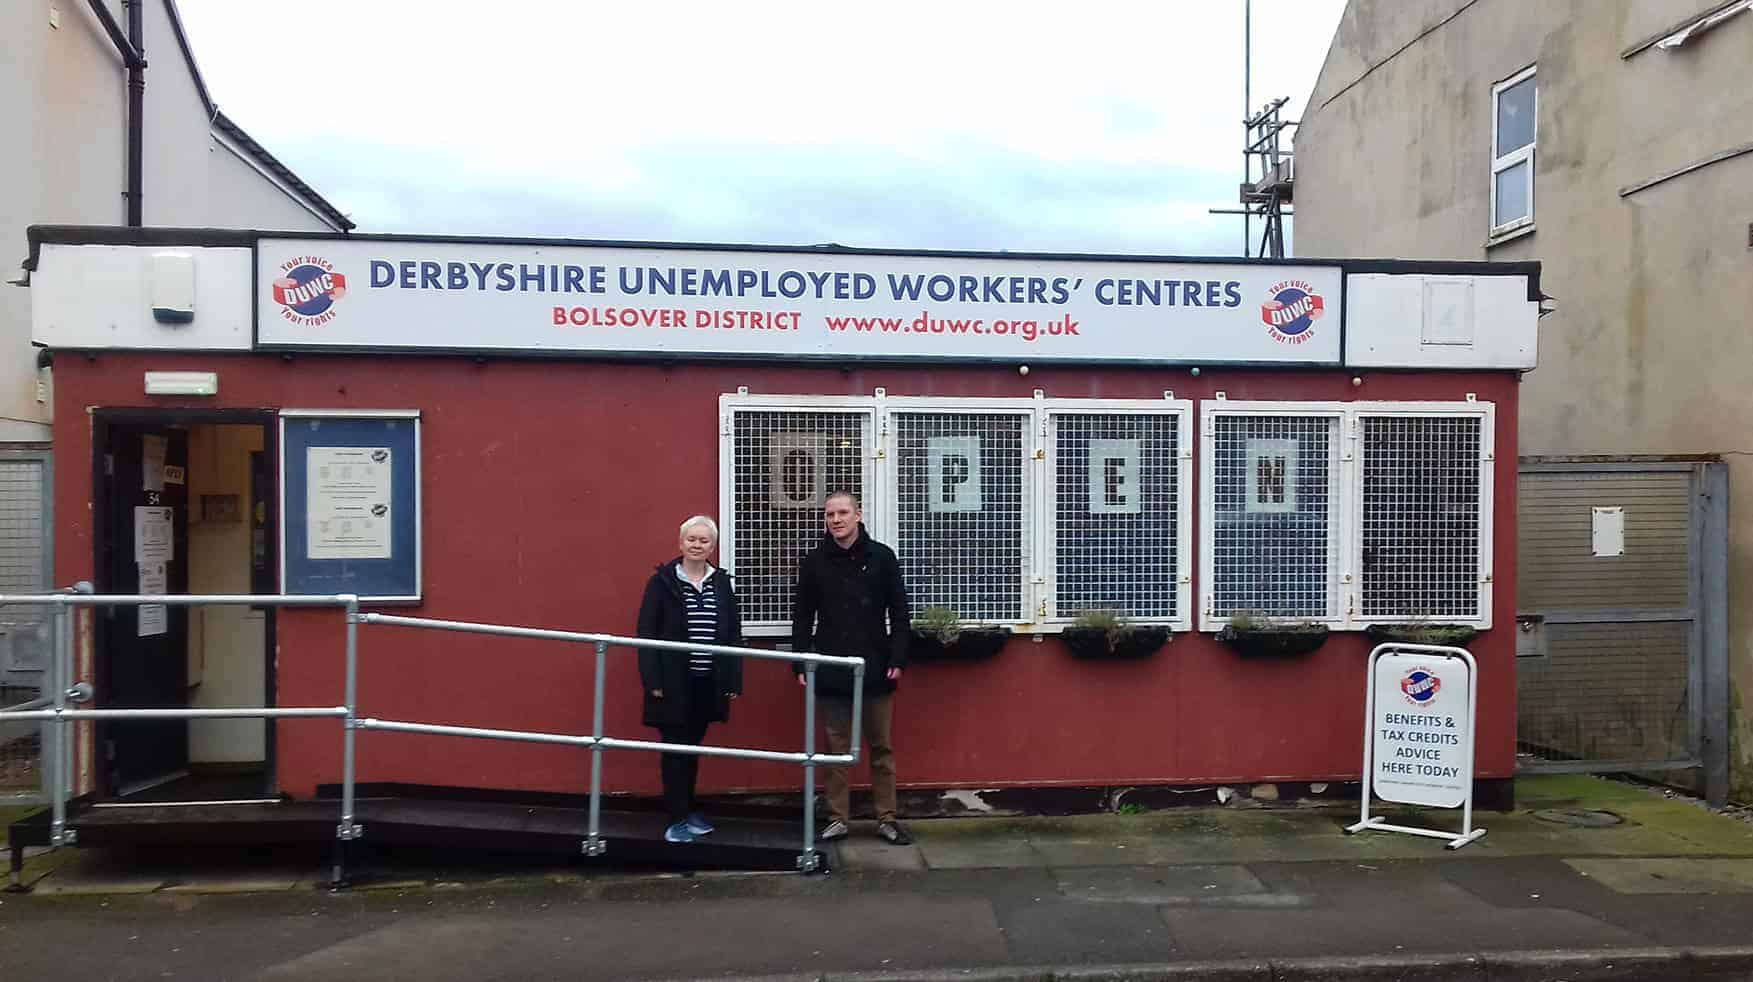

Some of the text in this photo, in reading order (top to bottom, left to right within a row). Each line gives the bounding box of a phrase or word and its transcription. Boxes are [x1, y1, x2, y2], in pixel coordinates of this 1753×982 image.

[279, 255, 334, 273] Your voice
[283, 273, 335, 305] DUWC
[370, 260, 606, 293] DERBYSHIRE
[619, 267, 876, 300] UNEMPLOYED
[1095, 279, 1242, 308] CENTRES
[1268, 280, 1314, 296] Your voice
[280, 306, 337, 327] Your rights
[553, 307, 801, 331] BOLSOVER DISTRICT
[1271, 296, 1314, 325] DUWC
[825, 311, 1080, 341] www.duwc.org.uk
[1267, 326, 1315, 345] Your rights
[1385, 713, 1456, 728] BENEFITS &
[1382, 729, 1459, 745] TAX CREDITS
[1396, 747, 1441, 760] ADVICE
[1382, 762, 1459, 778] HERE TODAY
